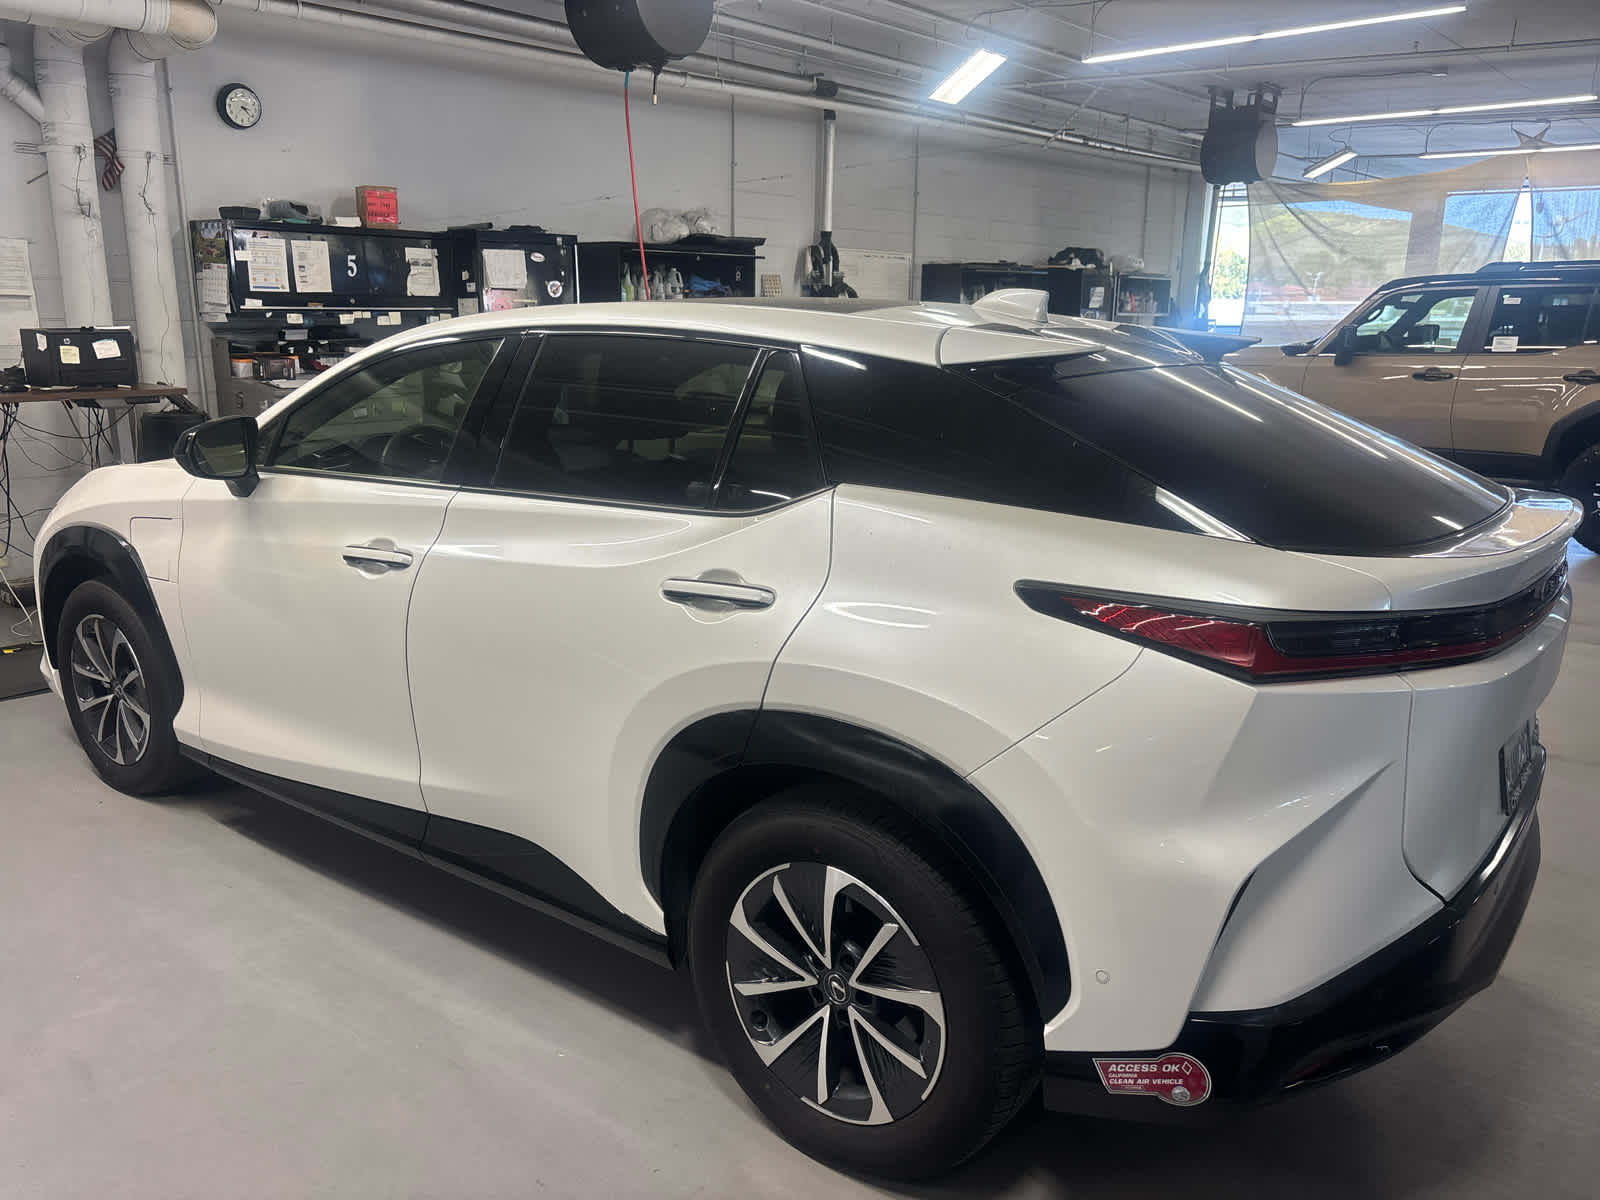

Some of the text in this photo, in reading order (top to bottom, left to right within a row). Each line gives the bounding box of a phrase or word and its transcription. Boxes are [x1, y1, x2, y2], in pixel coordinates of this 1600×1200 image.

[347, 254, 357, 277] 5
[1108, 1064, 1180, 1072] ACCESS OK
